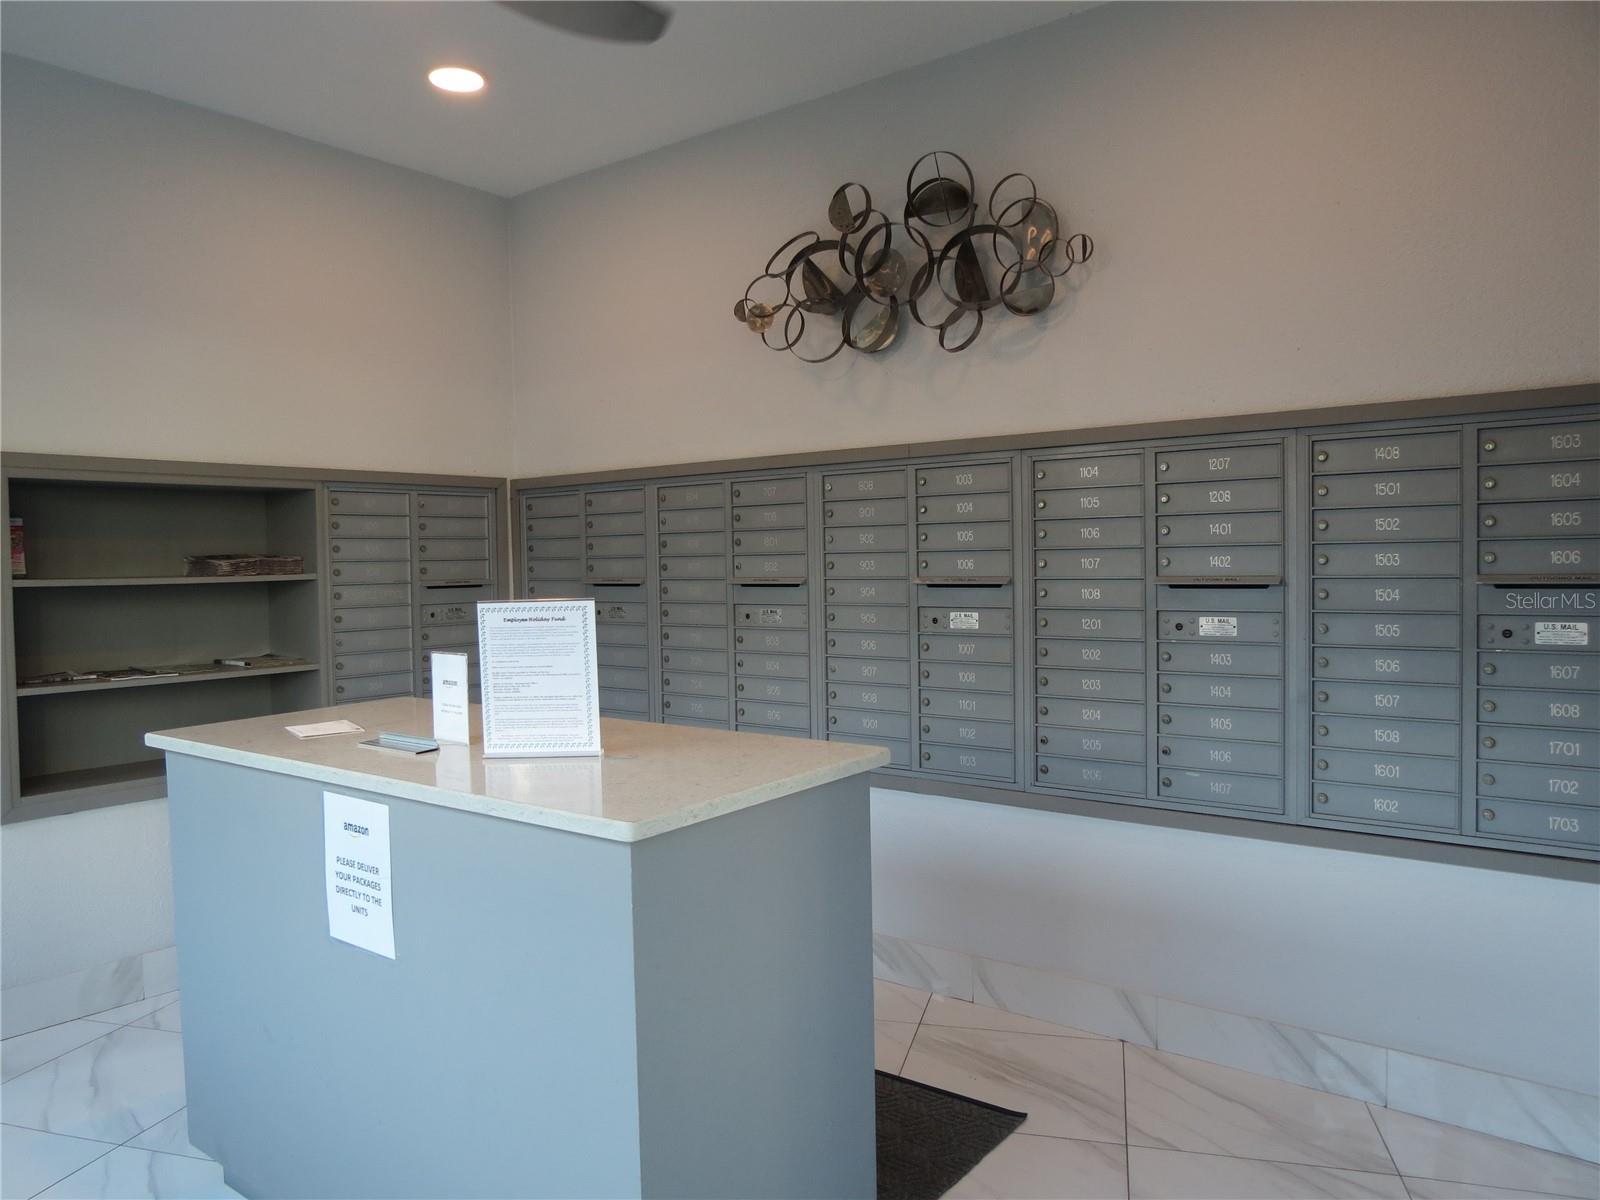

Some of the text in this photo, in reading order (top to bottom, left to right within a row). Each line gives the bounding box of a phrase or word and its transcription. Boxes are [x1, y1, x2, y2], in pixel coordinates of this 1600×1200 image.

[1550, 434, 1581, 449] 1603
[1374, 447, 1400, 460] 1408
[1209, 458, 1230, 470] 1207
[1080, 466, 1098, 478] 1104
[956, 475, 972, 485] 1003
[1551, 473, 1581, 487] 1604
[1374, 482, 1400, 495] 1501
[1080, 496, 1100, 508] 1105
[1209, 490, 1231, 503] 1208
[858, 507, 875, 517] 901
[956, 503, 973, 512] 1004
[1374, 518, 1400, 531] 1502
[1550, 512, 1581, 526] 1605
[1080, 528, 1100, 539] 1106
[1209, 523, 1232, 535] 1401
[957, 531, 974, 541] 1005
[1080, 557, 1100, 569] 1107
[1209, 556, 1231, 568] 1402
[1374, 553, 1400, 566] 1503
[1550, 550, 1581, 564] 1606
[859, 560, 875, 570] 903
[1081, 587, 1100, 599] 1108
[1374, 589, 1400, 601] 1504
[1081, 618, 1102, 629] 1201
[1374, 624, 1400, 636] 1505
[958, 643, 975, 653] 1007
[1082, 648, 1101, 660] 1202
[1209, 653, 1232, 665] 1403
[1374, 659, 1400, 672] 1506
[1549, 665, 1580, 679] 1607
[1082, 679, 1101, 690] 1203
[1209, 685, 1231, 698] 1404
[959, 700, 976, 711] 1101
[1374, 694, 1400, 708] 1507
[1082, 708, 1101, 720] 1204
[1549, 704, 1580, 718] 1608
[1209, 718, 1232, 730] 1405
[959, 728, 976, 739] 1102
[1374, 729, 1400, 742] 1508
[1082, 739, 1102, 750] 1205
[1549, 741, 1580, 756] 1701
[960, 756, 976, 766] 1103
[1209, 750, 1232, 762] 1406
[1082, 769, 1102, 781] 1206
[1374, 764, 1400, 778] 1601
[1209, 782, 1231, 794] 1407
[1549, 779, 1579, 794] 1702
[1373, 799, 1399, 813] 1602
[344, 821, 369, 835] amazon
[1548, 817, 1578, 832] 1703
[336, 856, 379, 875] PLEASE DELIVER
[336, 871, 381, 891] YOUR PACKAGES
[336, 885, 382, 907] DIRECTLY TO THE
[352, 904, 368, 916] UNITS
